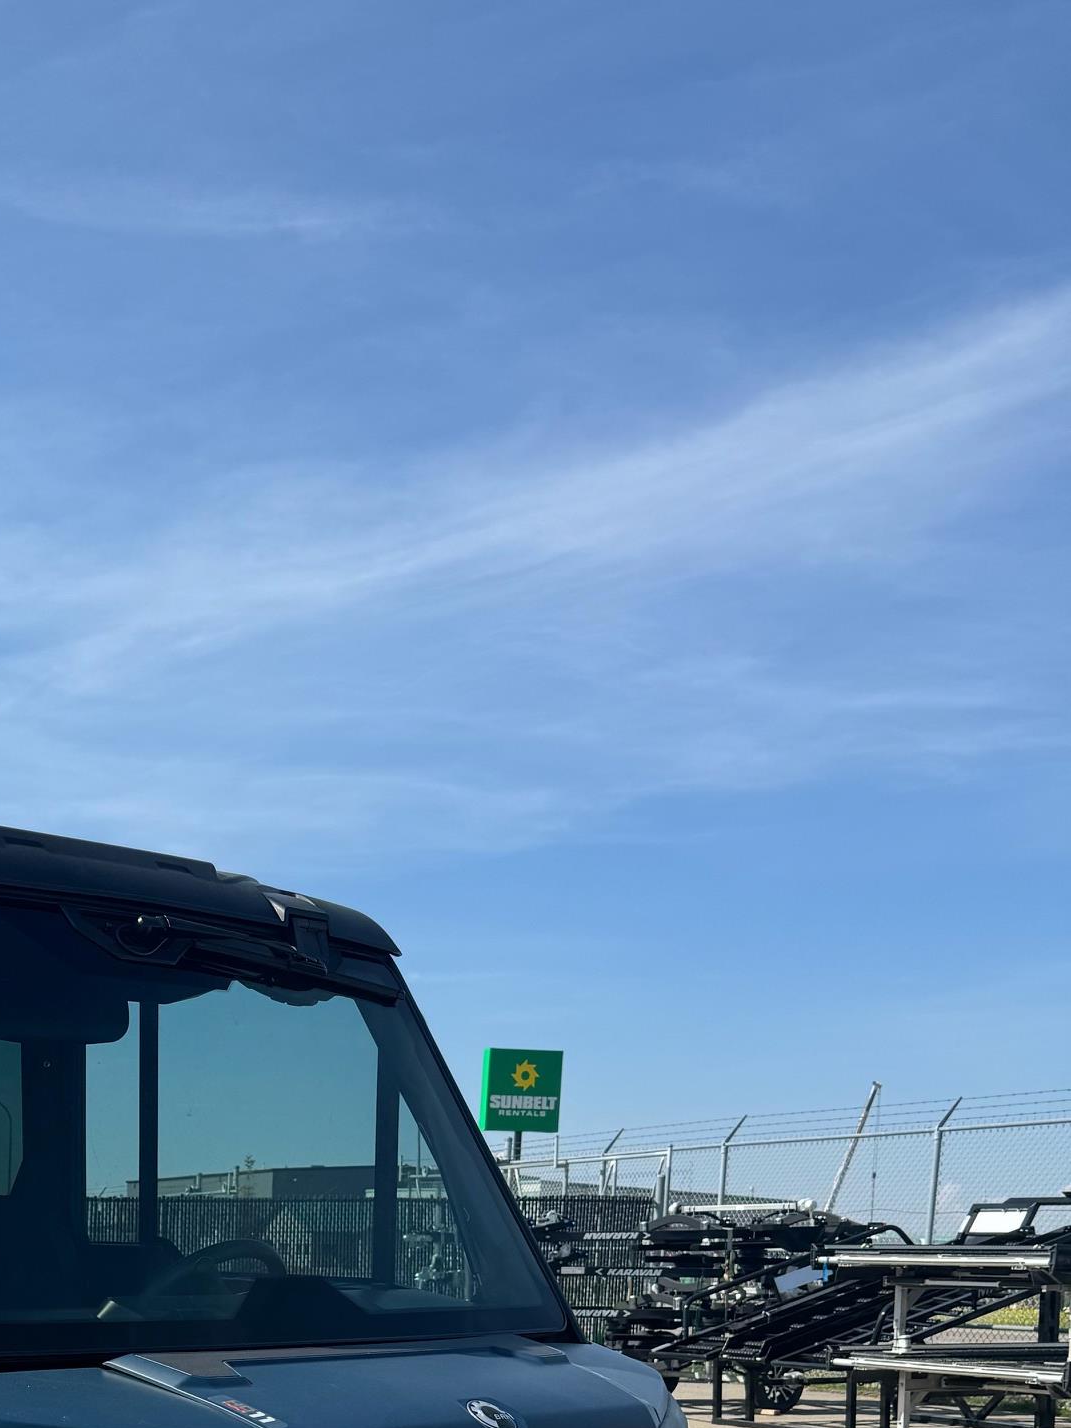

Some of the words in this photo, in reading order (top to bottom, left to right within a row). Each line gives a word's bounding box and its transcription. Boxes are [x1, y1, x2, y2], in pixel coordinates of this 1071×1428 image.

[489, 1094, 558, 1110] SUNBELT
[583, 1232, 639, 1240] KARAVAN
[606, 1268, 663, 1276] KARAVAN
[572, 1309, 619, 1317] KARAVA
